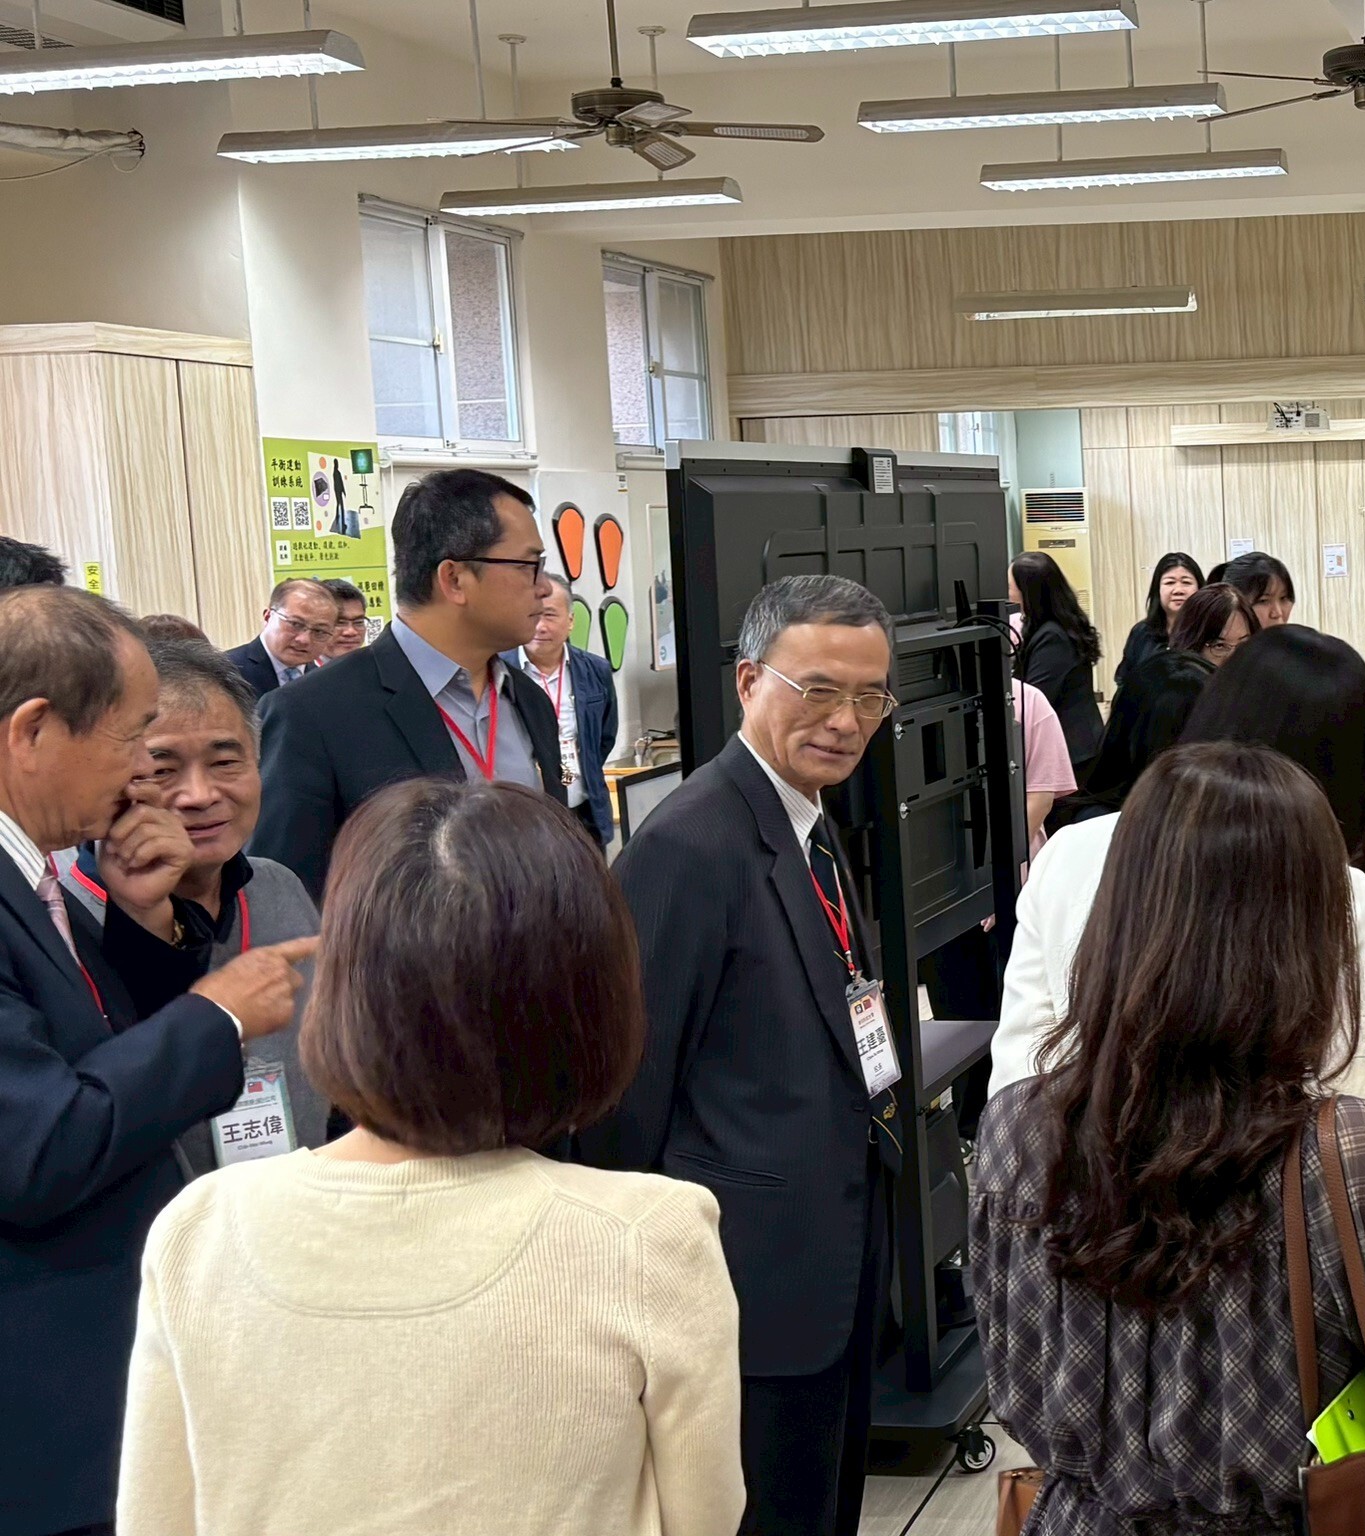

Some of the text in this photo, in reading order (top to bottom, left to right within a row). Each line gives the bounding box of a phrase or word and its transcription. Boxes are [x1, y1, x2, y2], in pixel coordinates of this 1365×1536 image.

[271, 458, 301, 471] 平衡運動
[272, 476, 303, 488] 訓練系統
[87, 565, 99, 589] 安全
[222, 1115, 284, 1144] 王志偉
